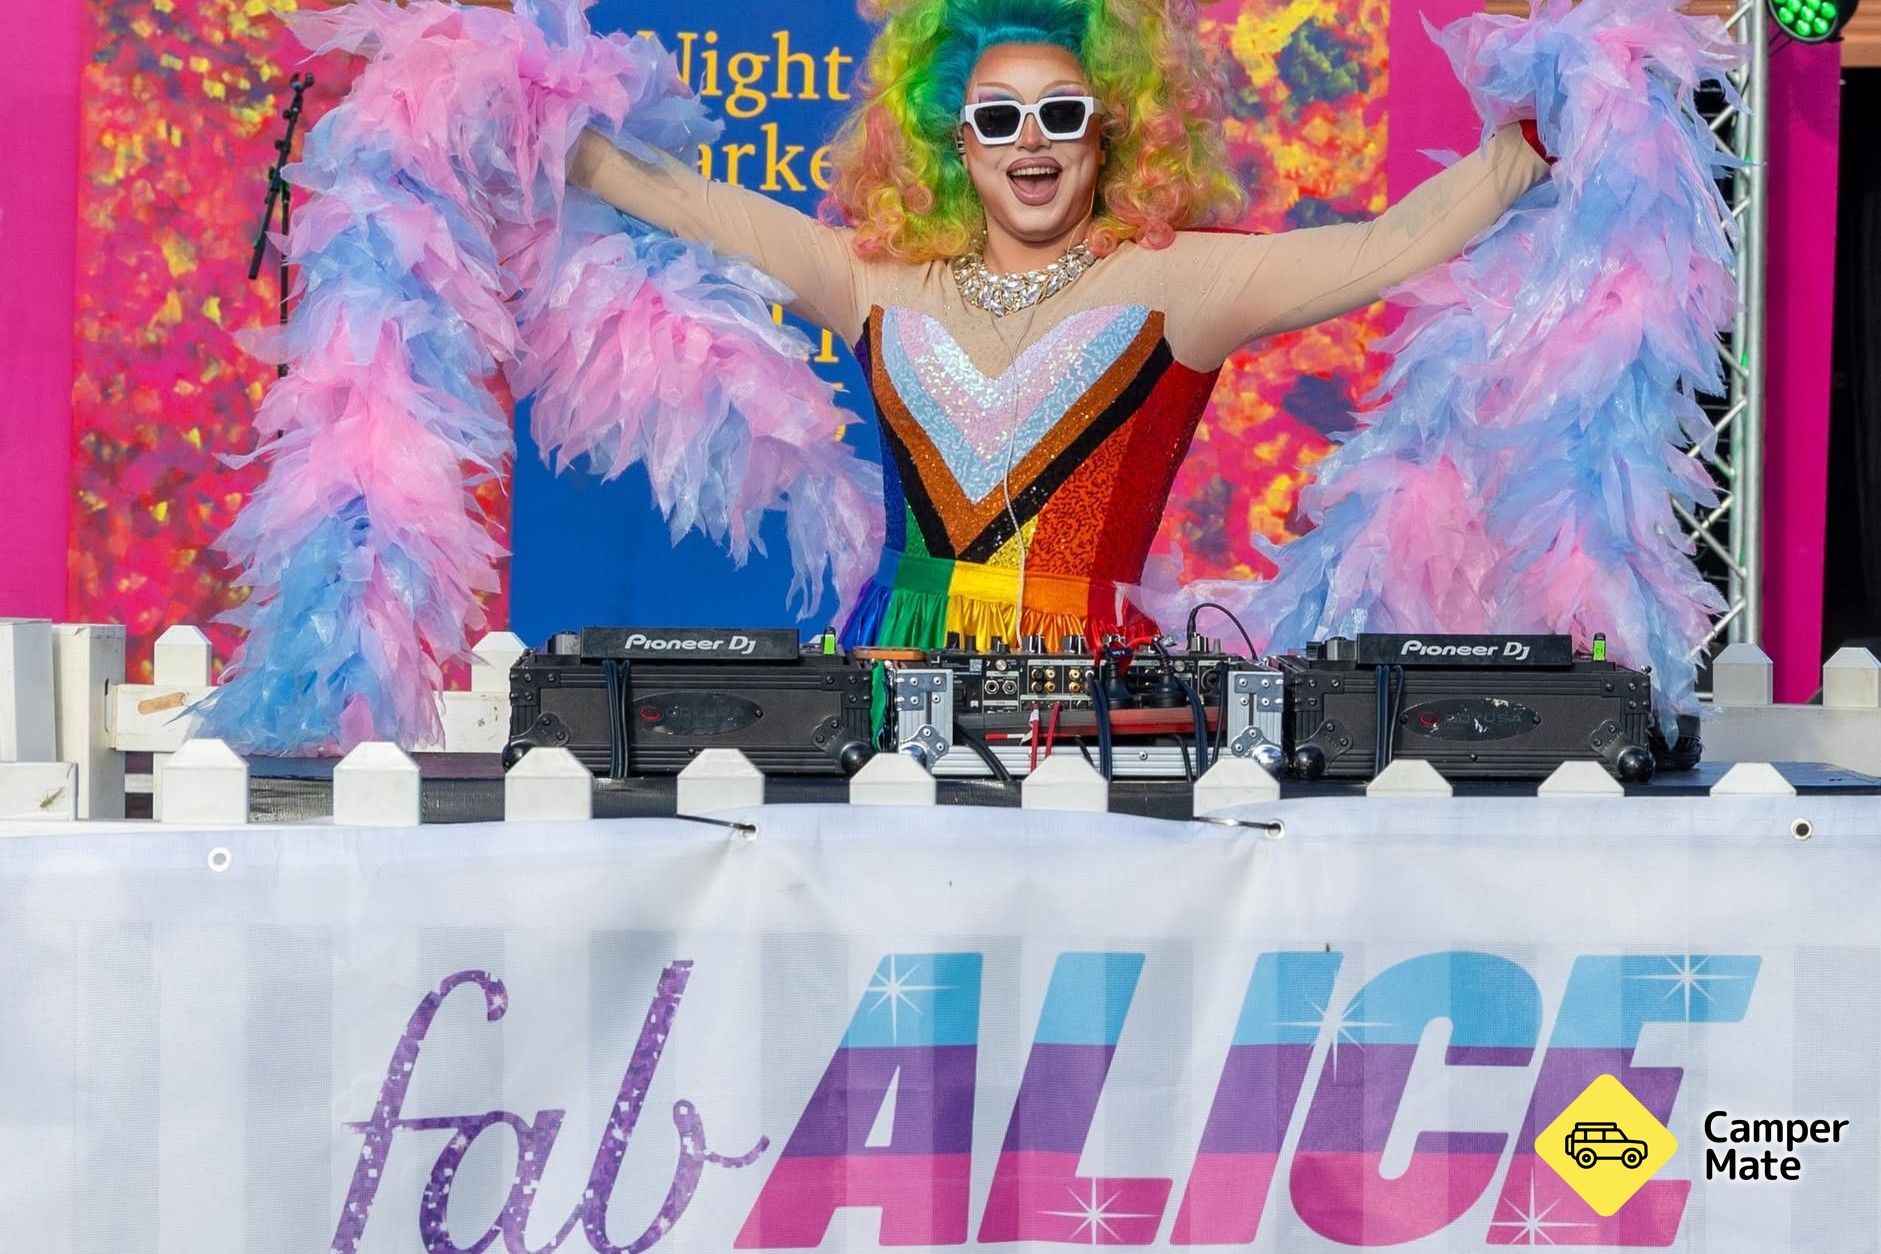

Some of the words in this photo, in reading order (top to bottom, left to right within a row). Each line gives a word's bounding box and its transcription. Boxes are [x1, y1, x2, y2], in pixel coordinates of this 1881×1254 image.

[697, 122, 833, 192] arke
[624, 633, 724, 650] Pioneer
[1401, 639, 1498, 656] Pioneer
[329, 959, 770, 1254] fab
[733, 951, 1763, 1249] ALICE
